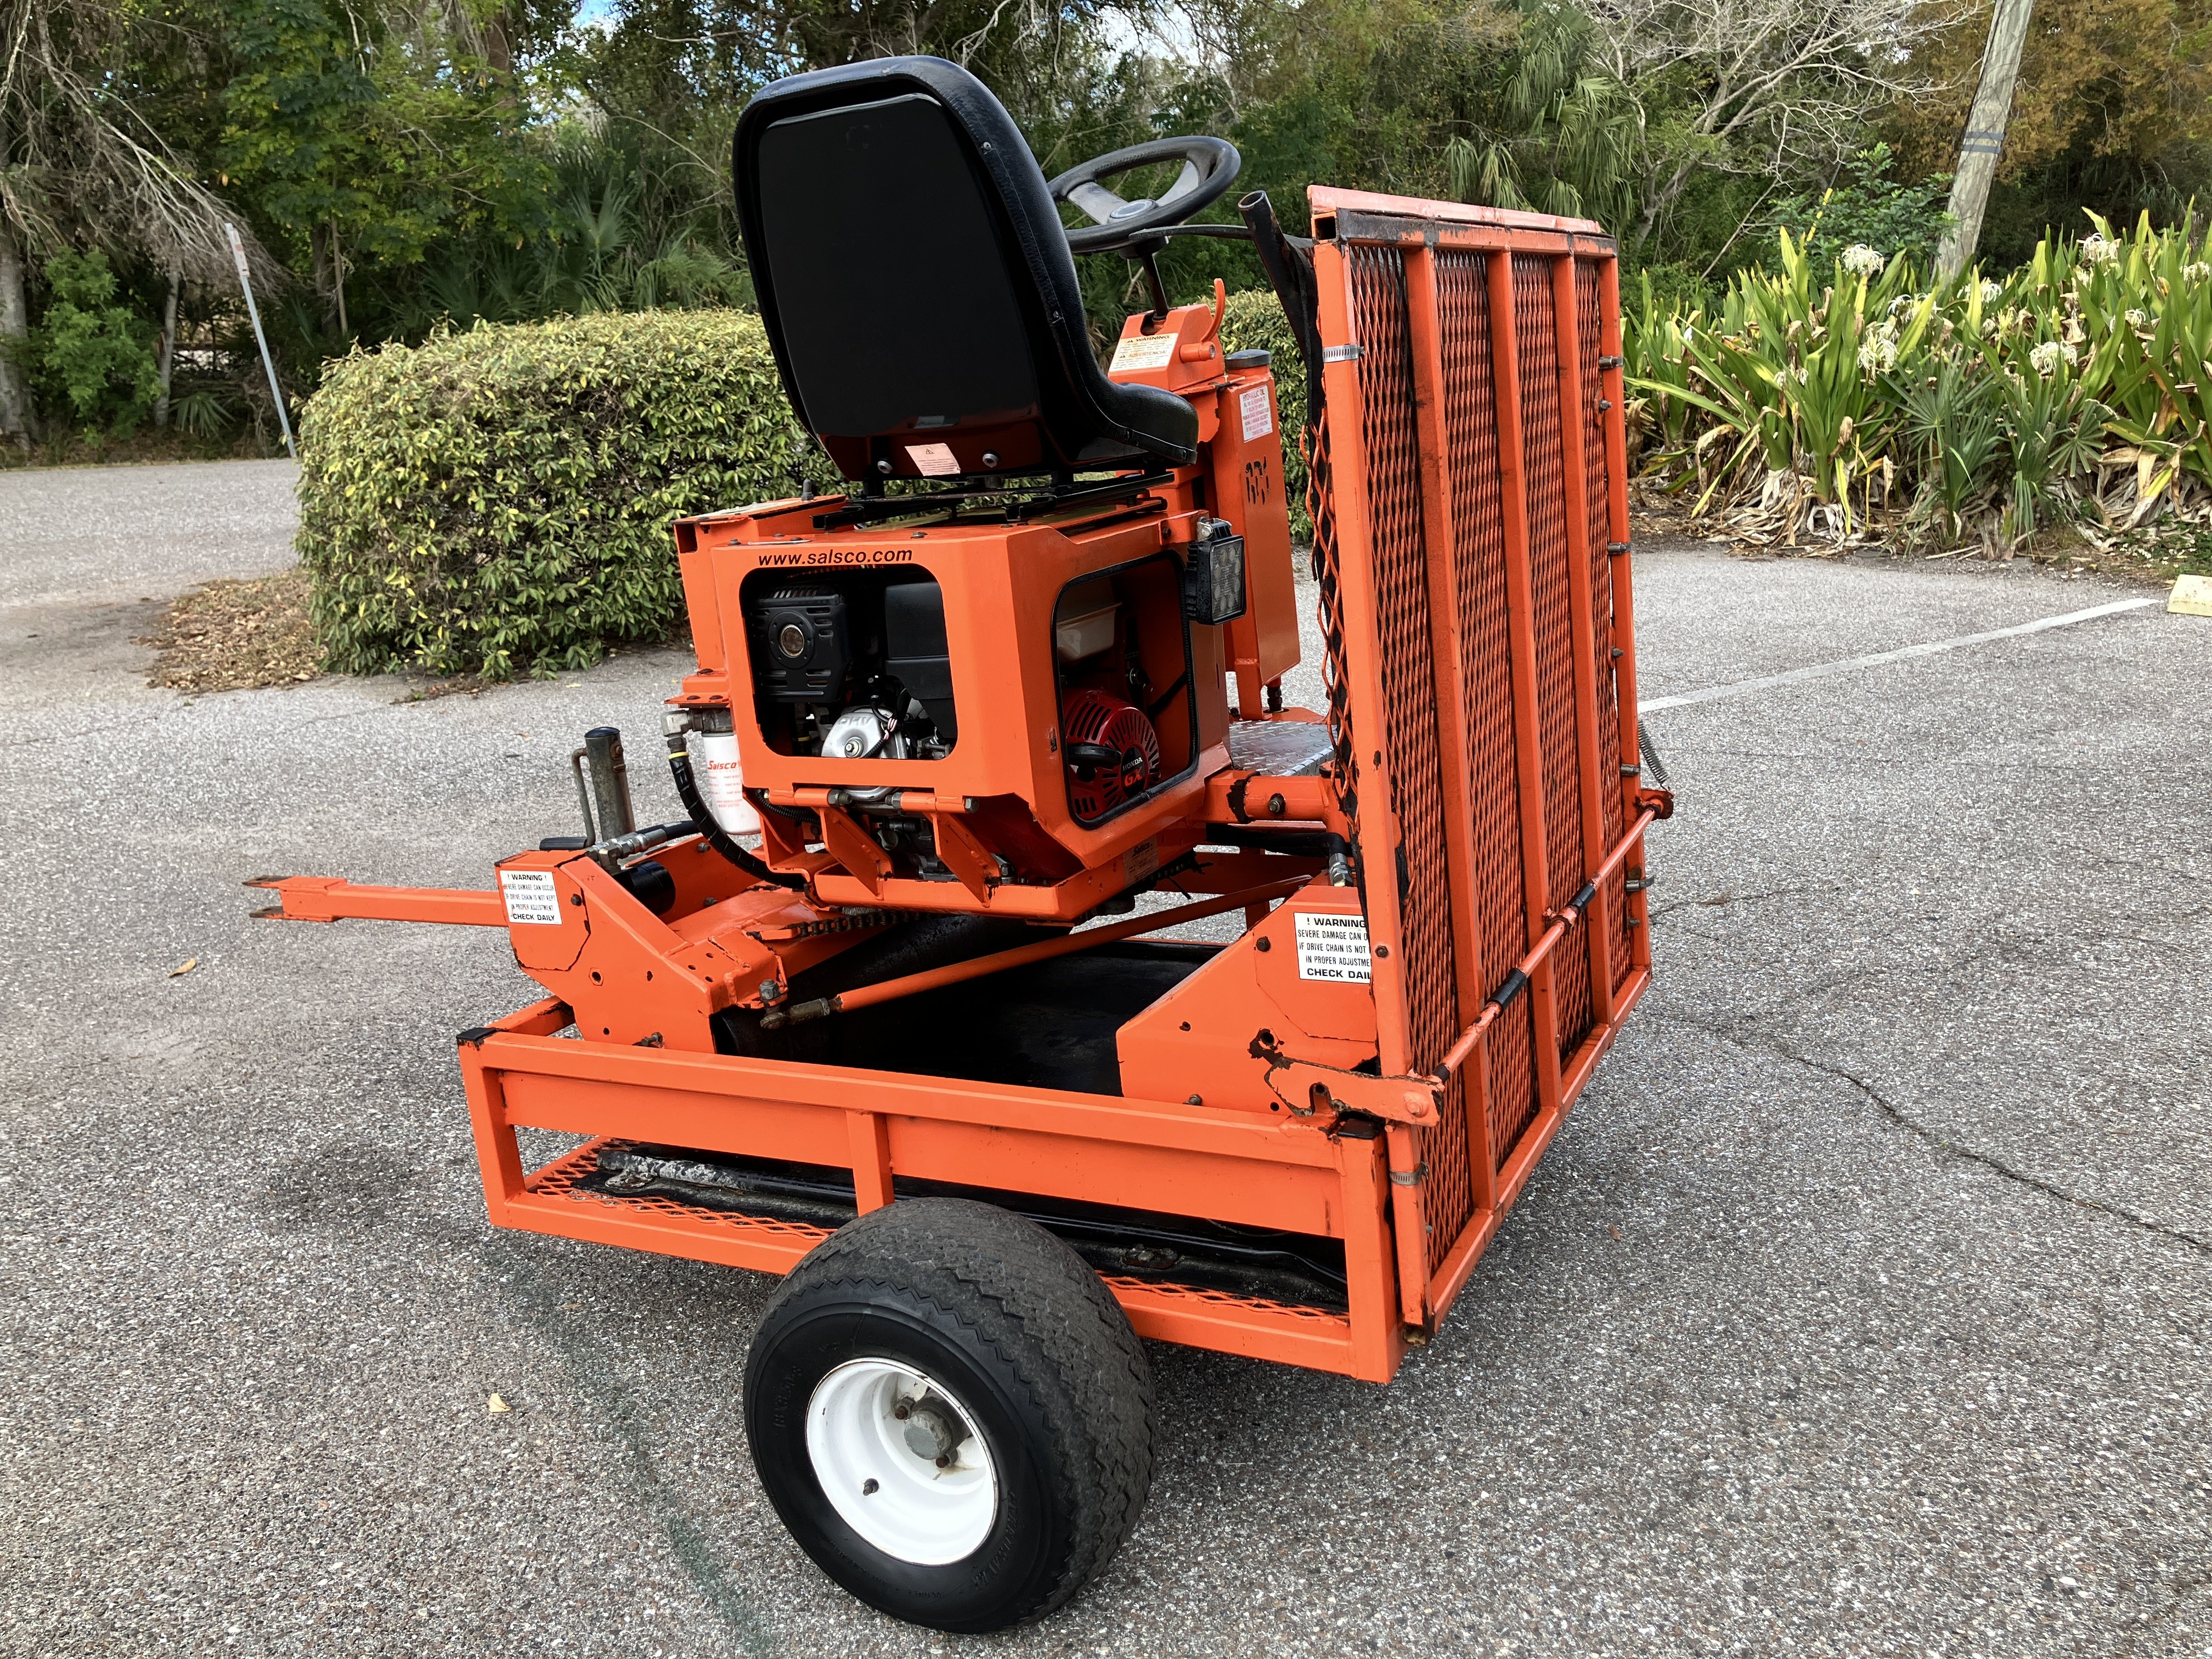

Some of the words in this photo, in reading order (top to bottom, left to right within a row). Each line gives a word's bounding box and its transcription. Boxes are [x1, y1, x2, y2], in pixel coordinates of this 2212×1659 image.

[759, 549, 912, 566] www.salsco.com
[707, 760, 737, 770] Salsco
[1122, 757, 1143, 772] HONDA
[1124, 766, 1143, 787] GX
[1313, 917, 1366, 928] WARNING
[1297, 929, 1320, 938] SEVERE
[1322, 930, 1347, 940] DAMAGE
[1349, 932, 1362, 940] CAN
[1299, 942, 1305, 950] IF
[1307, 943, 1324, 951] DRIVE
[1326, 944, 1344, 952] CHAIN
[1346, 945, 1352, 953] IS
[1355, 945, 1367, 953] NOT
[1306, 955, 1312, 963] IN
[1314, 956, 1336, 965] PROPER
[1339, 957, 1372, 967] ADJUSTME
[1307, 968, 1344, 978] CHECK
[1348, 970, 1370, 979] DAIL
